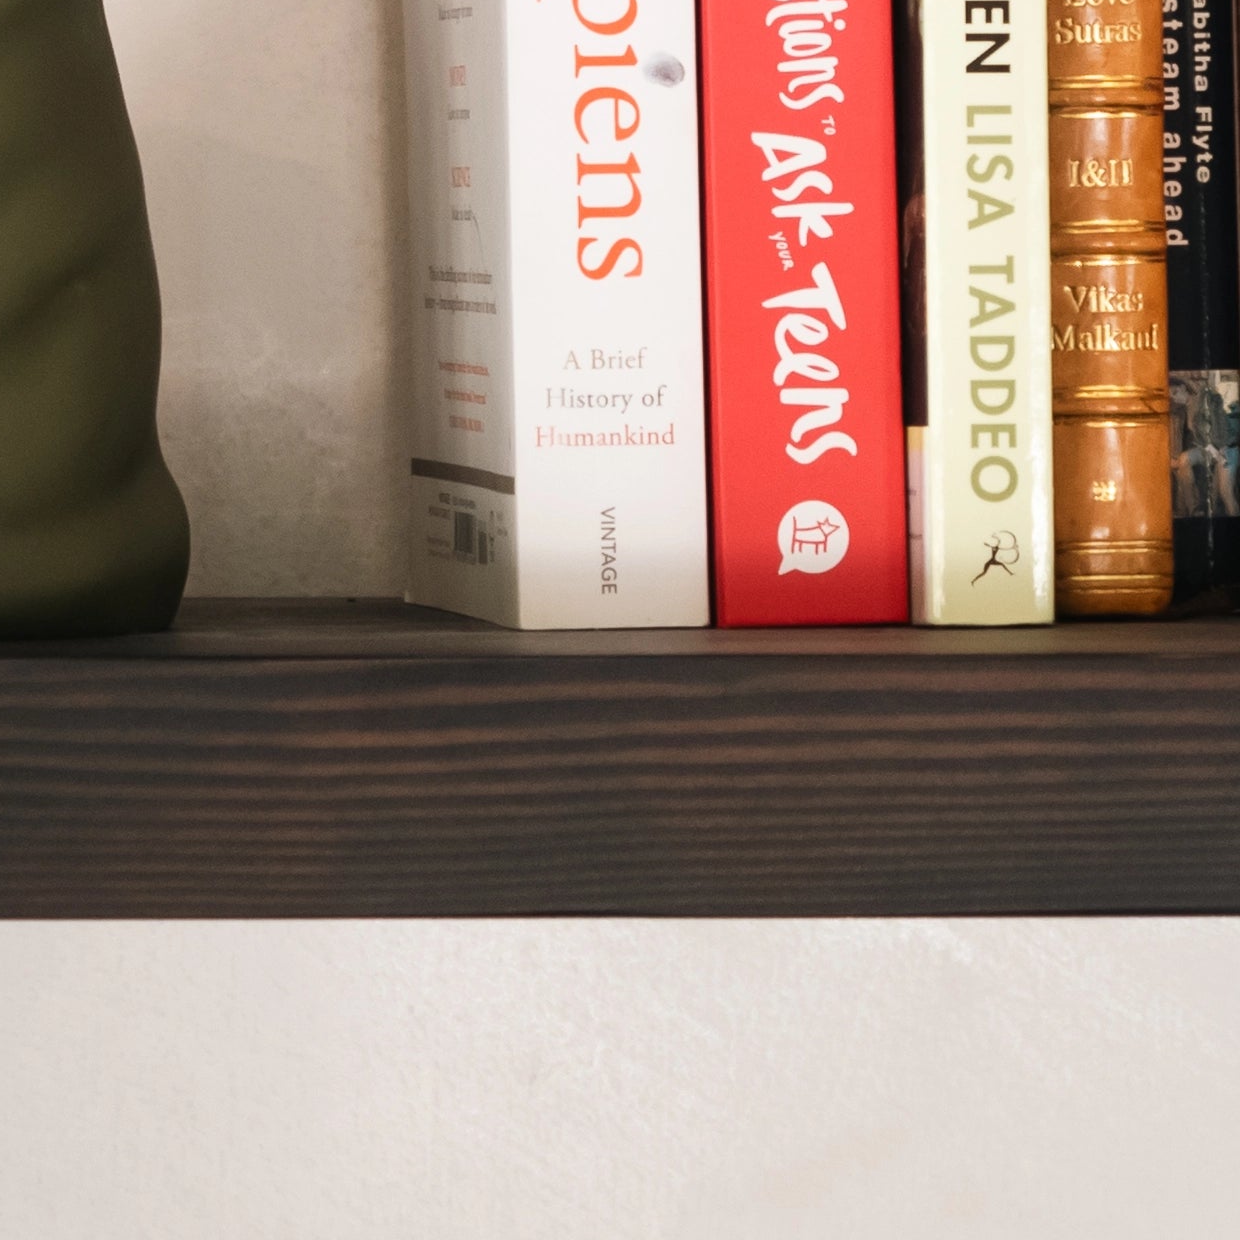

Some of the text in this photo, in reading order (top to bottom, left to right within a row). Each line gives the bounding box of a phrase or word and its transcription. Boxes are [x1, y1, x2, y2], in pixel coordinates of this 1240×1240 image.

[1055, 16, 1143, 45] Sutras
[965, 104, 1015, 232] LISA
[1192, 106, 1213, 184] Flyte
[1162, 132, 1189, 247] ahead
[768, 230, 795, 272] YOUR
[1063, 284, 1144, 313] Vikas
[563, 347, 648, 371] A Brief
[761, 261, 858, 465] Teens
[968, 255, 1019, 504] TADDEO
[545, 385, 668, 414] History of
[535, 424, 676, 448] Humankind
[599, 506, 619, 596] VINTAGE
